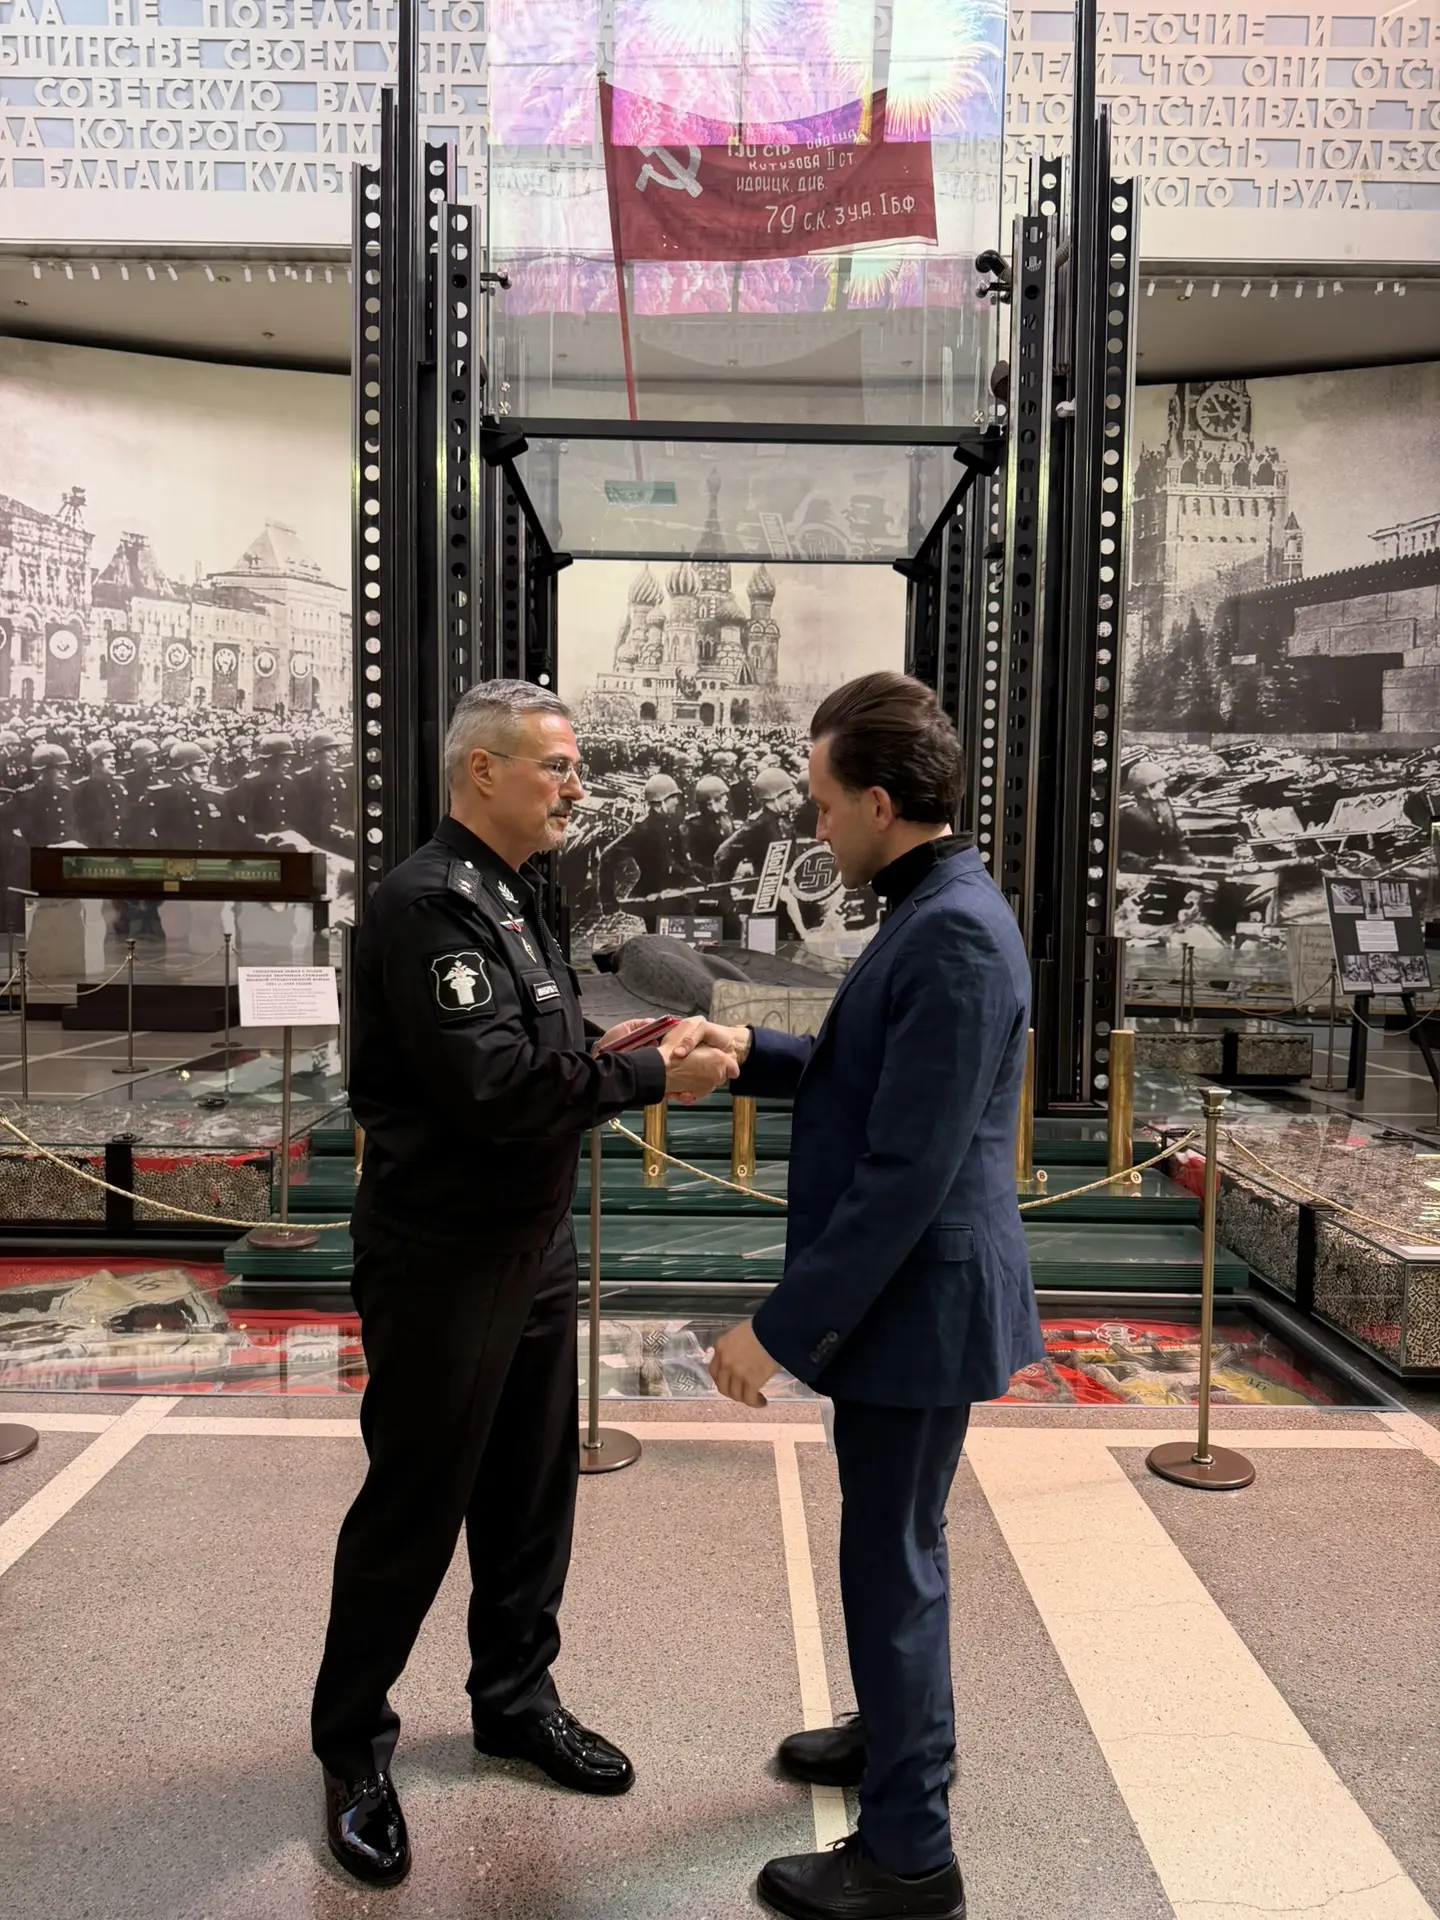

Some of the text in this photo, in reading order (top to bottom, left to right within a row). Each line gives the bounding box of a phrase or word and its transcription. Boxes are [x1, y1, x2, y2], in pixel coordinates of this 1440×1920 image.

[107, 0, 160, 26] НЕ
[203, 0, 397, 31] ПОБЕДЯТ
[1097, 12, 1266, 46] АБОЧИЕ
[1308, 15, 1331, 47] И
[223, 39, 354, 72] СВОЕМ
[1141, 54, 1212, 87] ЧТО
[1244, 56, 1327, 88] ОНИ
[35, 77, 281, 111] СОВЕТСКУЮ
[1110, 95, 1376, 130] ОТСТАИВАЮТ
[77, 119, 283, 152] КОТОРОГО
[318, 123, 373, 154] ИМ
[45, 160, 213, 190] БЛАГАМИ
[765, 204, 796, 234] 79
